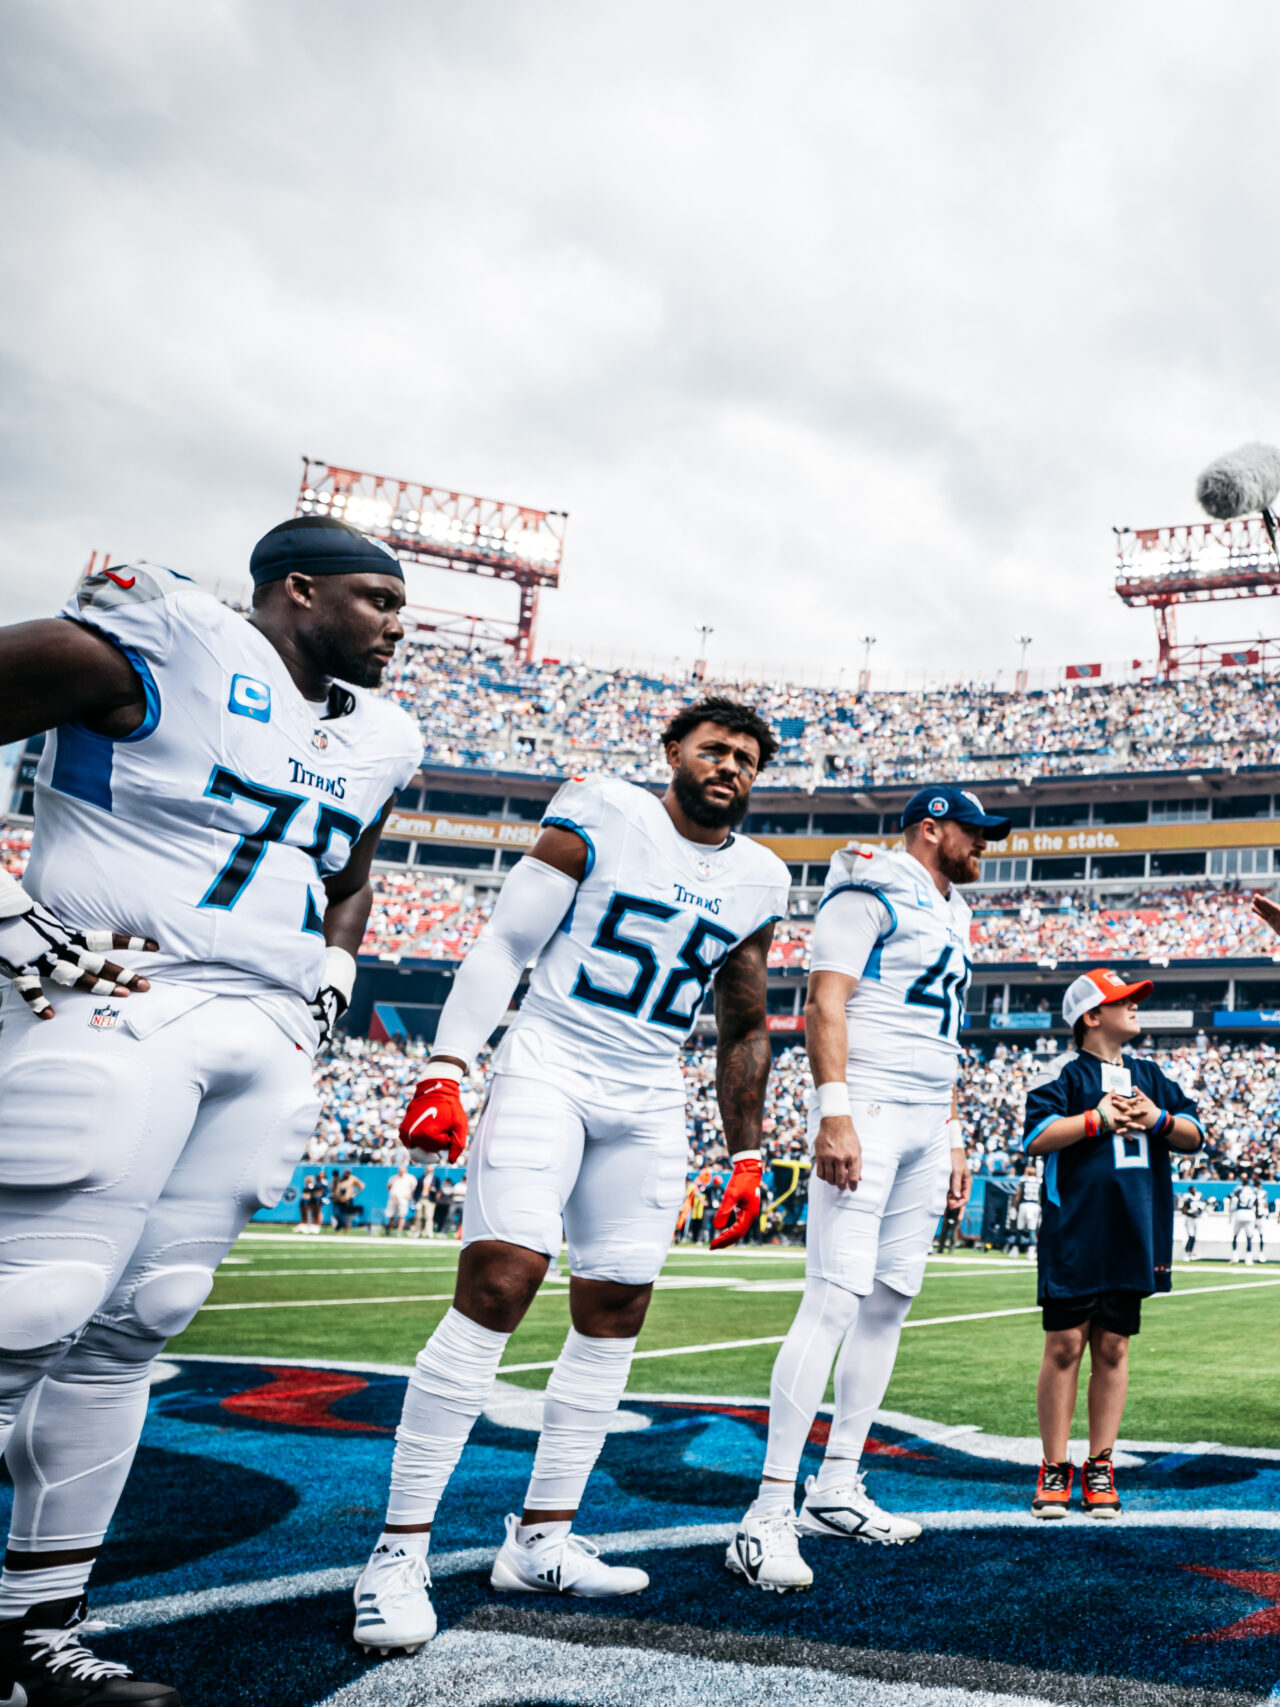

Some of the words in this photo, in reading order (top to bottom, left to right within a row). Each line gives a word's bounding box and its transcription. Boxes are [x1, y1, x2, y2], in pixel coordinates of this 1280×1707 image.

[386, 813, 432, 835] Farm
[434, 818, 495, 839] Bureau
[1012, 835, 1029, 851] in
[1033, 833, 1063, 850] the
[1068, 832, 1119, 849] state.
[568, 890, 740, 1032] 58
